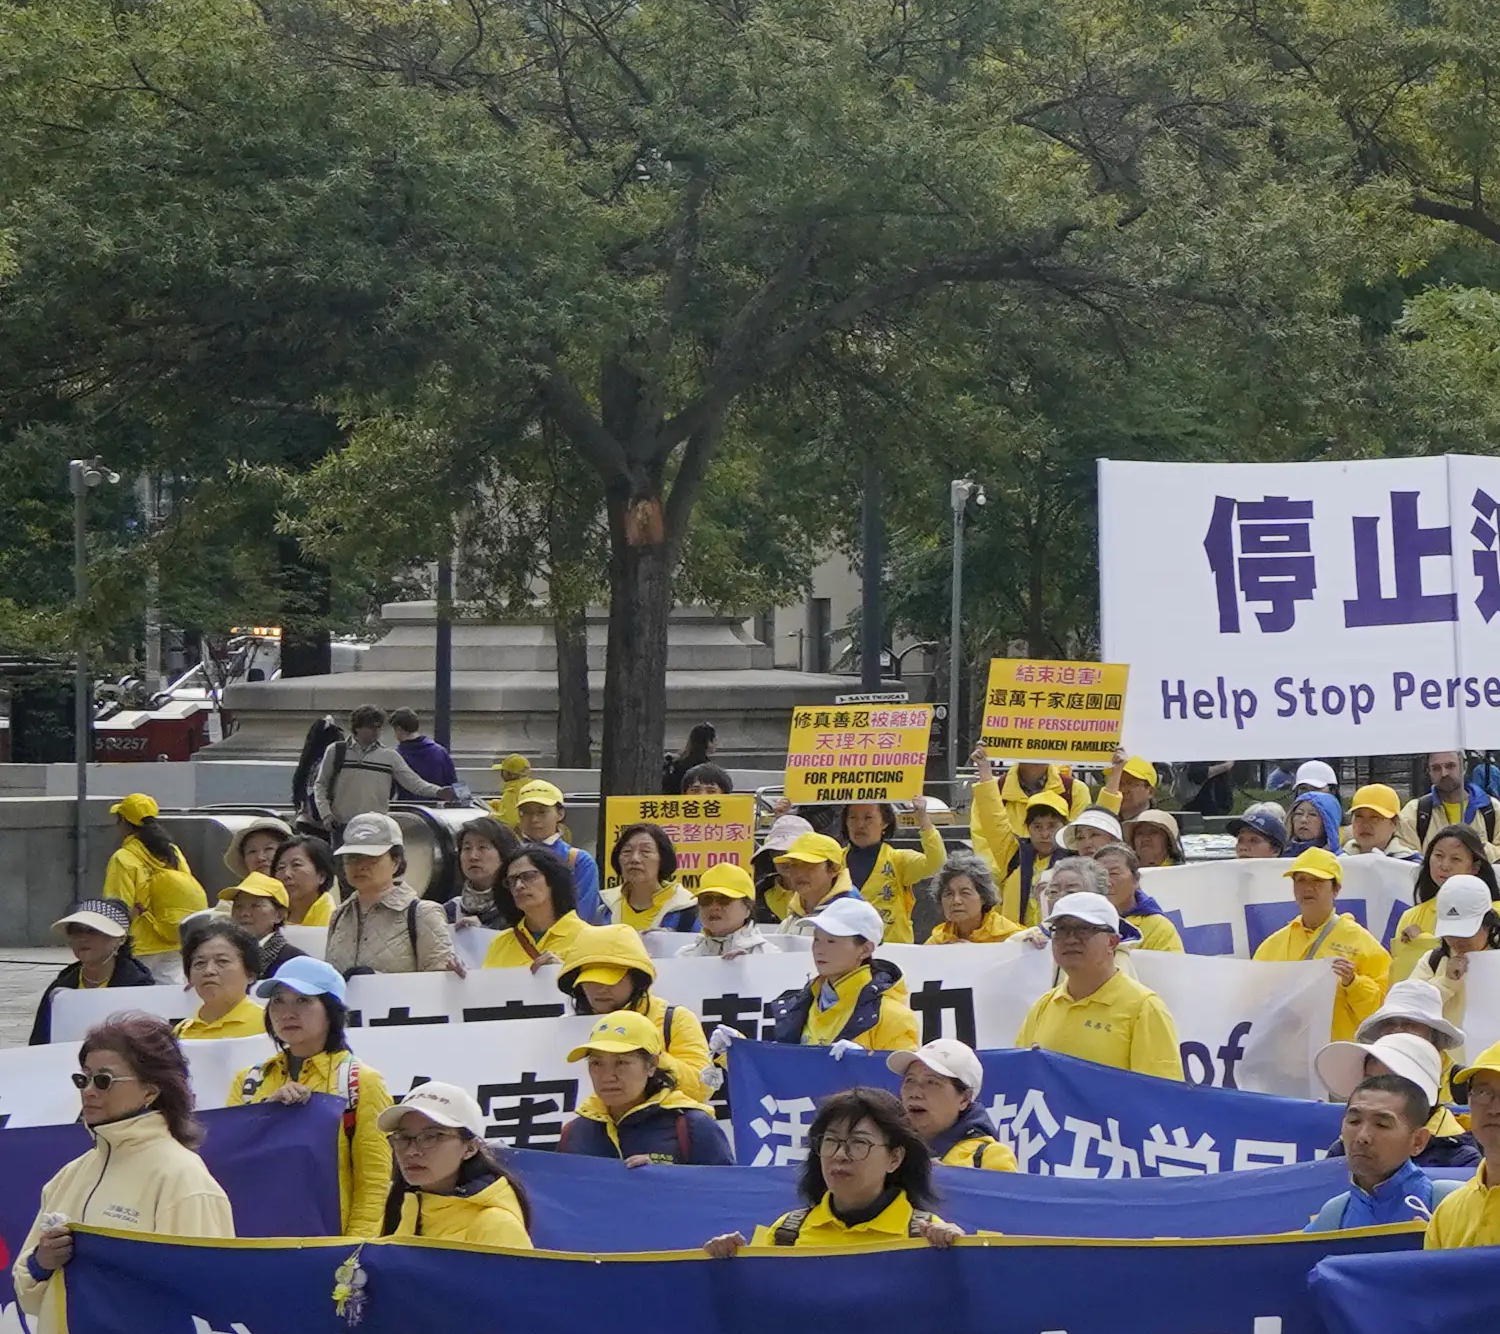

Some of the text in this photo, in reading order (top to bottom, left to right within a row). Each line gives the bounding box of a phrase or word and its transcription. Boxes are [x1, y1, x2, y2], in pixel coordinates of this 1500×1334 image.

[1015, 665, 1103, 685] 結束迫害!
[989, 689, 1122, 711] 還萬千家庭團圓
[1161, 676, 1258, 730] Help
[1275, 676, 1375, 725] Stop
[794, 708, 928, 729] 修真善忍被離婚
[986, 716, 1119, 734] END THE PERSECUTION!
[814, 733, 903, 751] 天理不容!
[1028, 738, 1068, 752] BROKEN
[787, 752, 926, 768] FORCED INTO DIVORCE
[804, 770, 904, 785] FOR PRACTICING
[816, 787, 887, 802] FALUN DAFA
[639, 801, 722, 819] 我想爸爸
